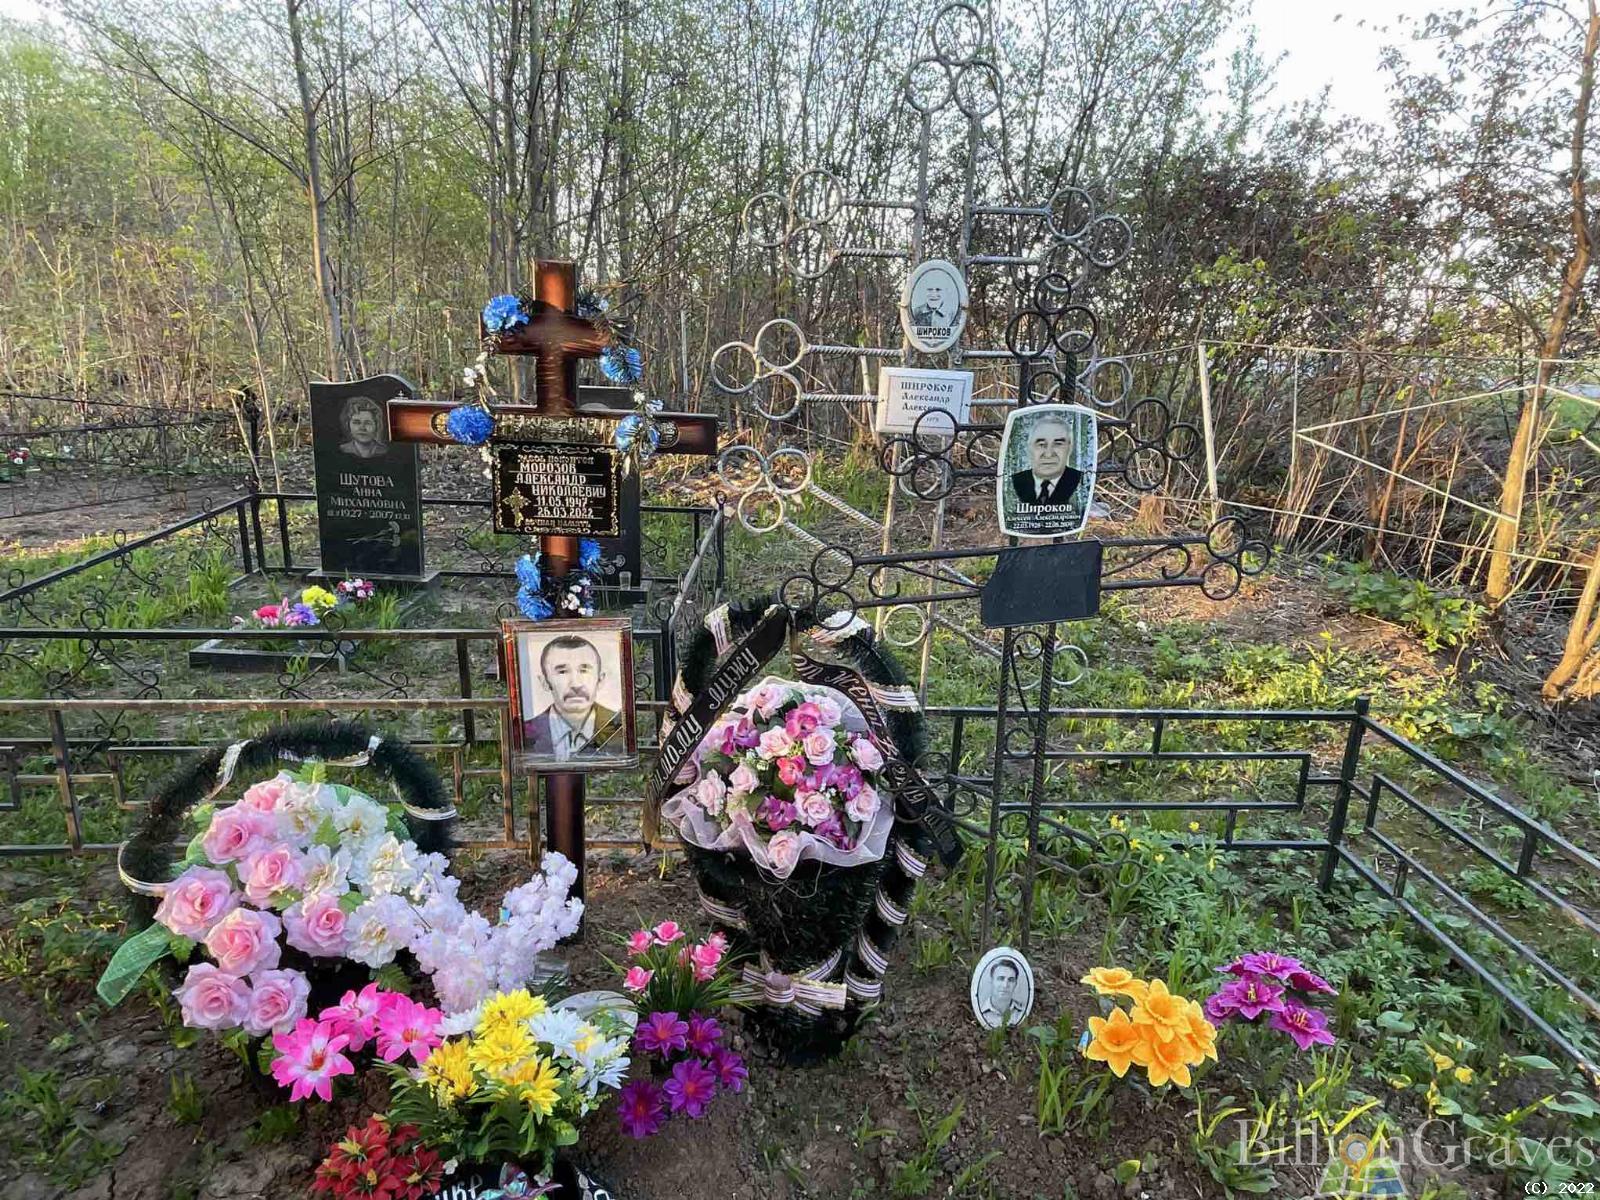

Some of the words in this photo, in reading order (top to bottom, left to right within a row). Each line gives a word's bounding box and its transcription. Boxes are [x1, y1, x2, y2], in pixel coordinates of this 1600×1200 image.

[916, 327, 951, 336] ШИРОКОВ
[901, 381, 954, 392] ШИРОКОВ
[901, 392, 950, 405] Александр
[519, 462, 577, 474] МОРОЗОВ
[339, 472, 394, 488] ШУТОВА
[514, 473, 587, 486] АЛЕКСАНДР
[352, 486, 383, 497] АННА
[531, 484, 606, 498] НИКОЛАЕВИЧ
[369, 510, 394, 519] 2007
[1016, 502, 1073, 515] Широков
